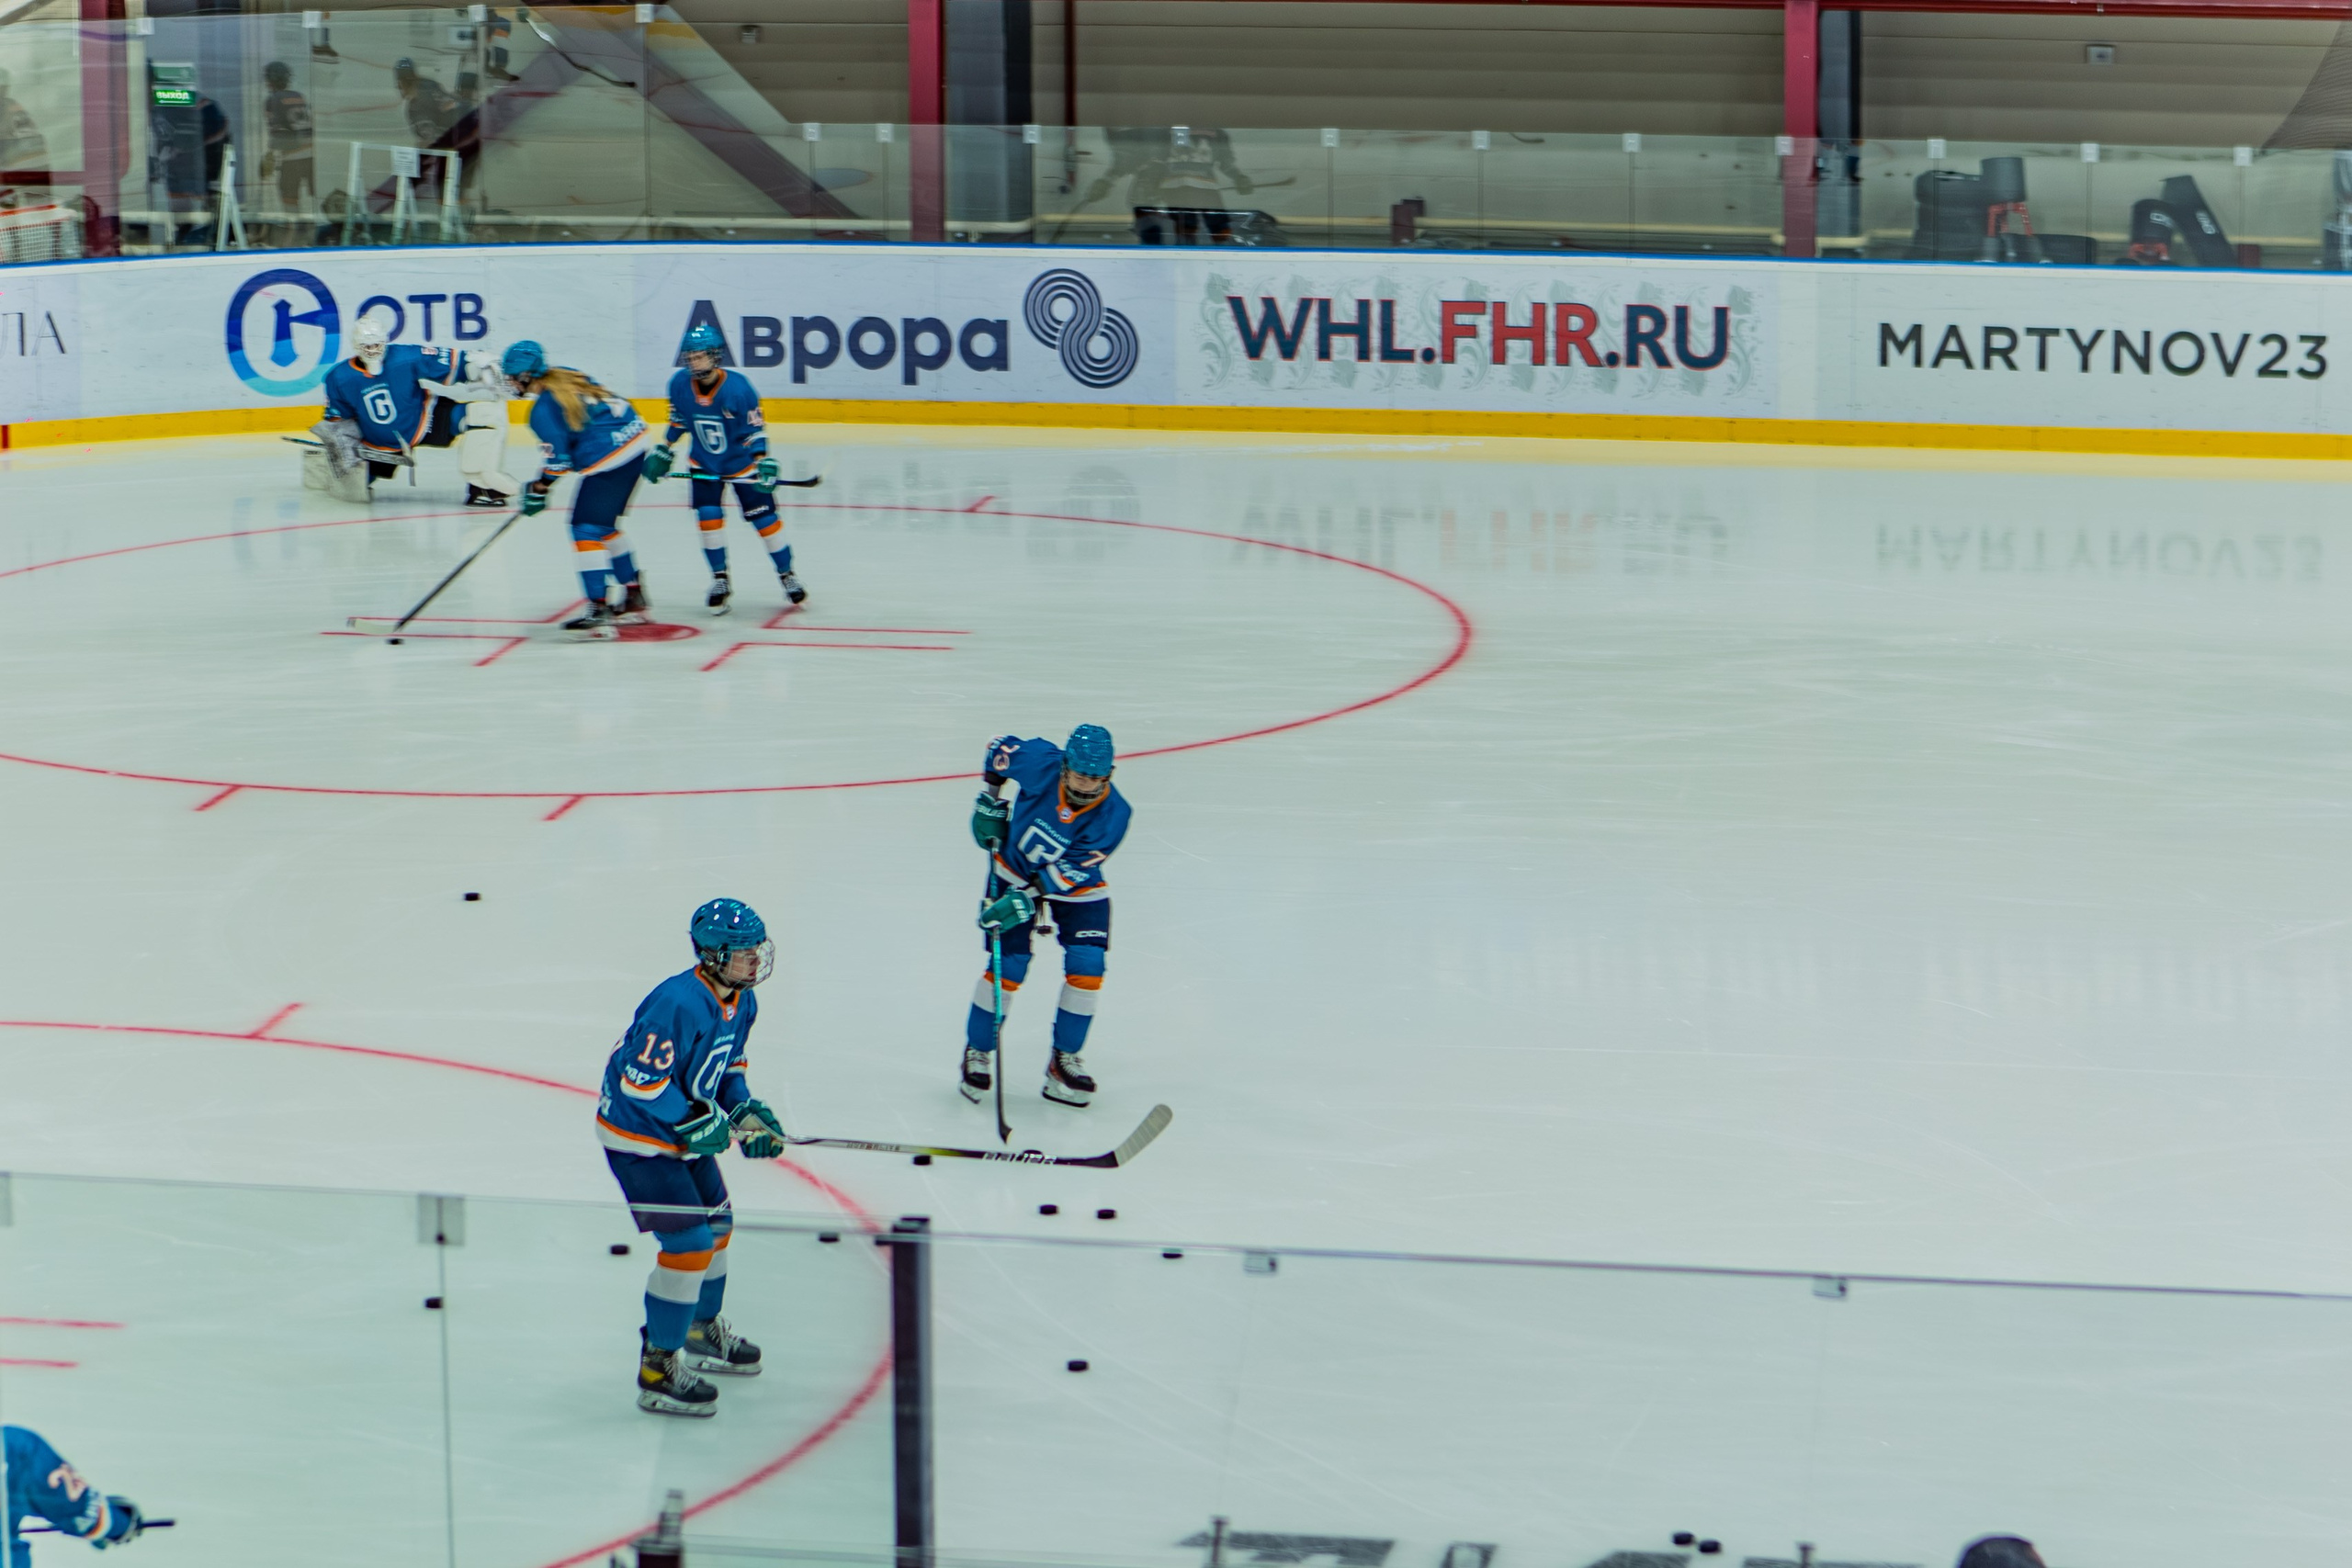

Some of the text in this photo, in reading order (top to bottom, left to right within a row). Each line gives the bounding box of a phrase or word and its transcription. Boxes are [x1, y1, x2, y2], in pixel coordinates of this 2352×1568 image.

[357, 292, 489, 344] ОТВ
[1227, 295, 1731, 371] WHL.FHR.RU
[1878, 321, 2328, 380] MARTYNOV23
[637, 1032, 675, 1071] 13
